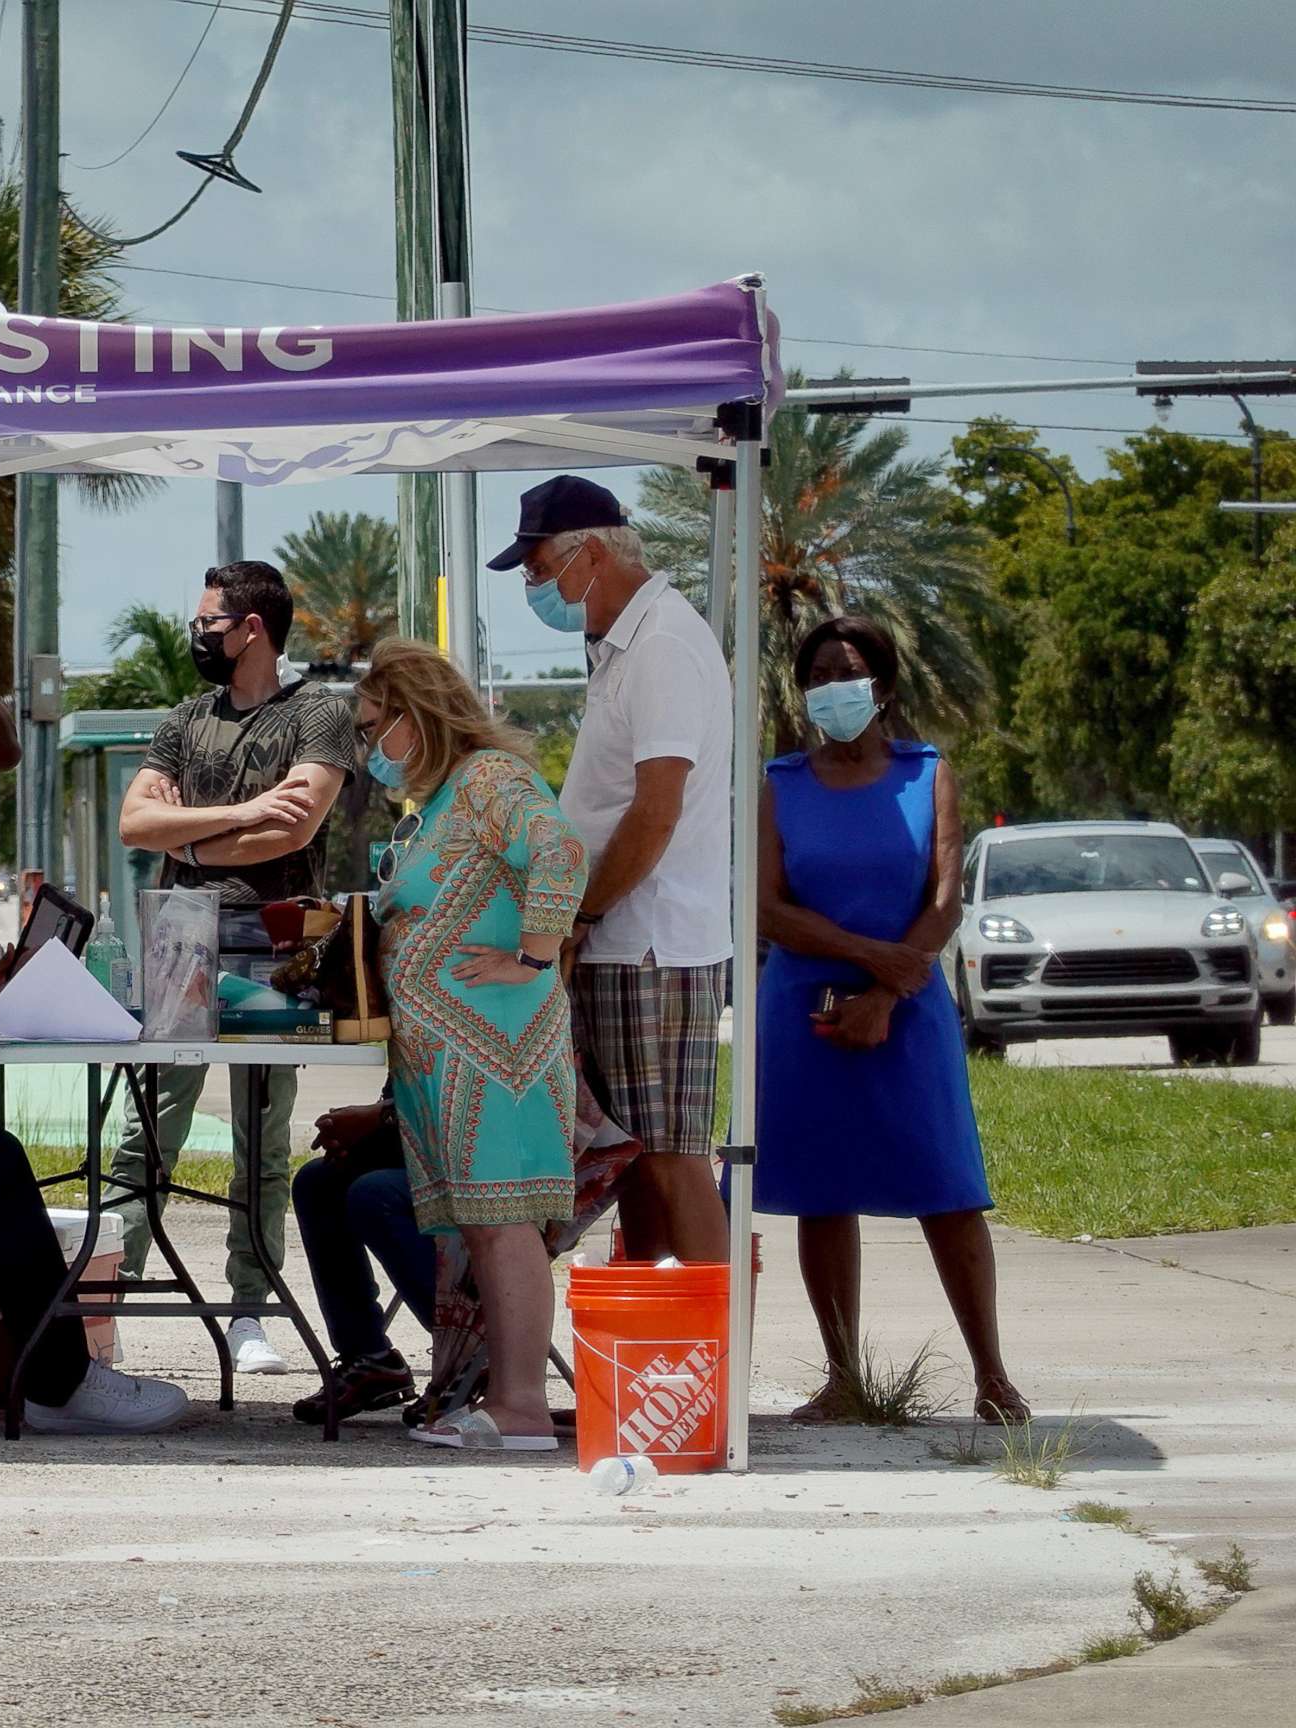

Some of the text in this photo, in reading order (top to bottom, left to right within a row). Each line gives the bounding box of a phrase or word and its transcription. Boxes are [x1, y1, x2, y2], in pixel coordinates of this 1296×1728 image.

[295, 1024, 331, 1034] GLOVES
[619, 1342, 718, 1454] HOME
[626, 1353, 674, 1400] THE
[660, 1382, 717, 1454] DEPOT
